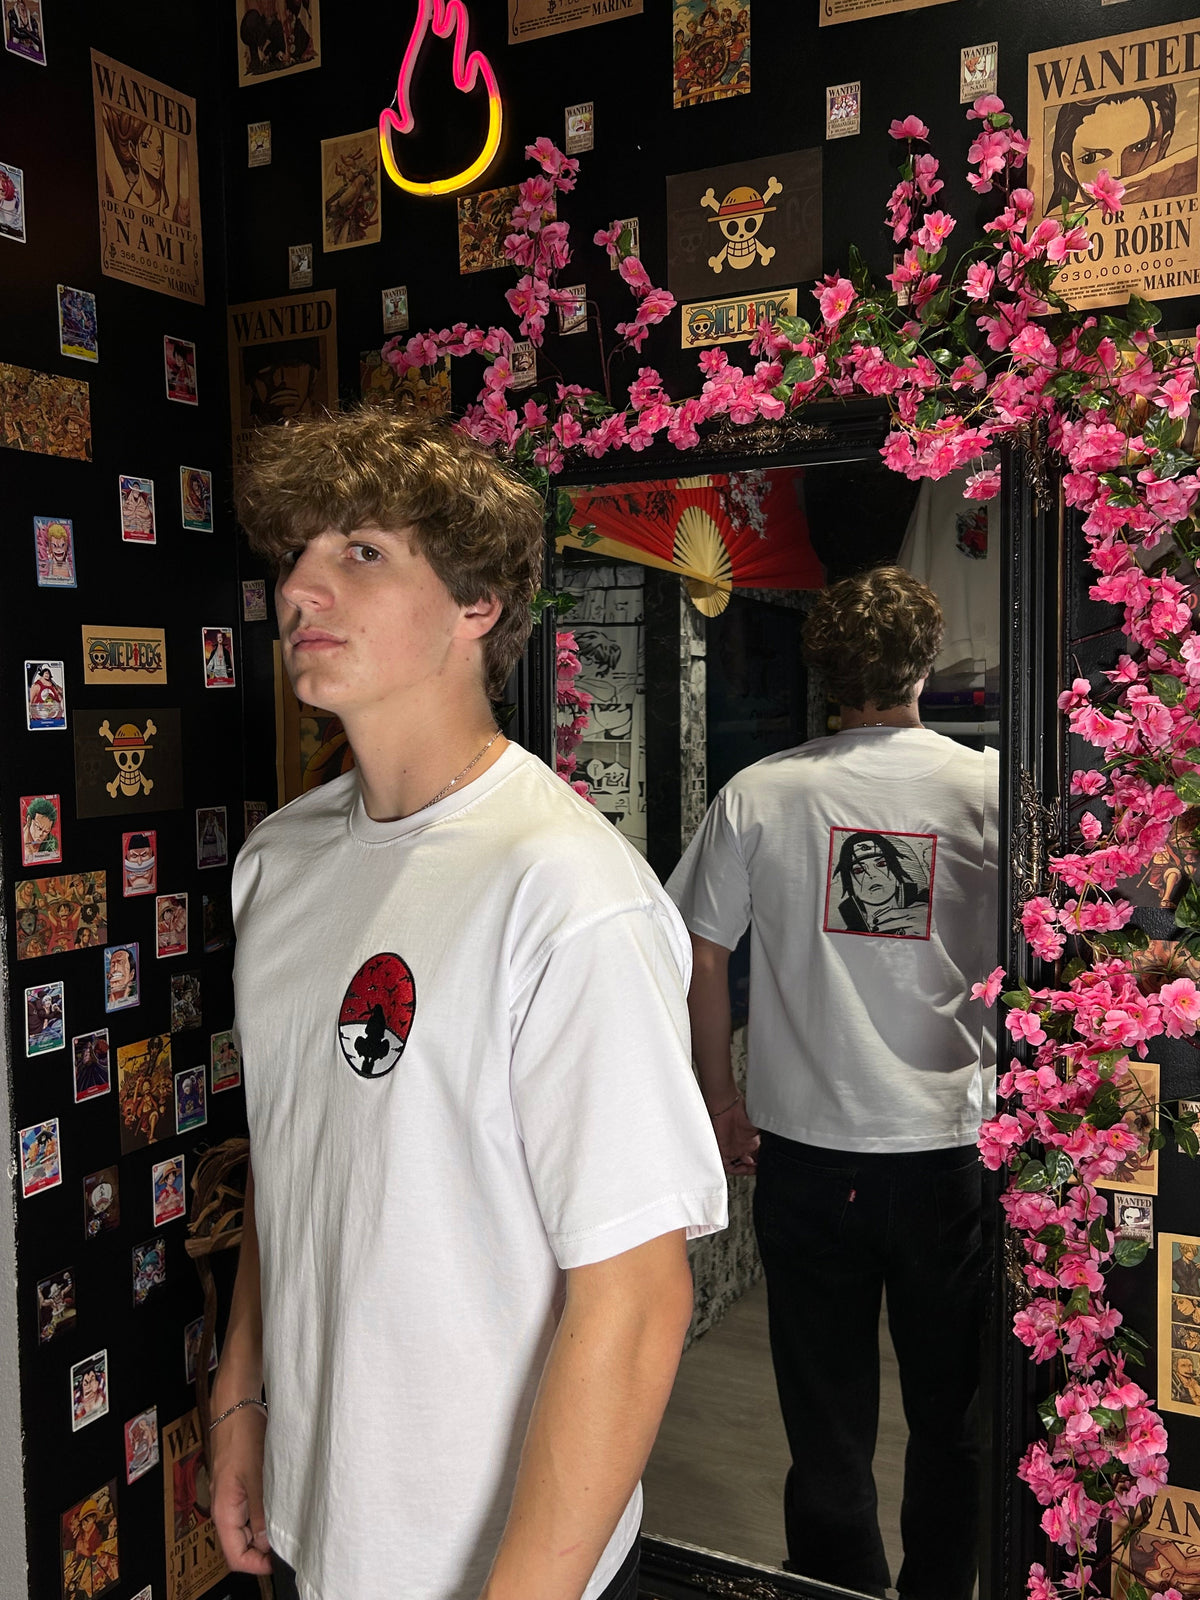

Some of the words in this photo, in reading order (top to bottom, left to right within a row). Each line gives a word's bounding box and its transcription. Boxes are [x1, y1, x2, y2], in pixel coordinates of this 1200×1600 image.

[963, 45, 997, 59] WANTED
[94, 61, 192, 136] WANTED
[829, 84, 860, 97] WANTED
[567, 105, 593, 116] WANTED
[1138, 198, 1199, 220] ALIVE
[106, 201, 135, 220] DEAD
[142, 214, 155, 228] OR
[162, 221, 193, 241] ALIVE
[116, 218, 185, 265] NAMI
[1114, 218, 1192, 258] ROBIN
[168, 277, 198, 297] MARINE
[384, 288, 407, 298] WANTED
[232, 300, 332, 343] WANTED
[89, 640, 125, 669] ONE
[1116, 1196, 1151, 1209] WANTED
[174, 1531, 199, 1556] DEAD
